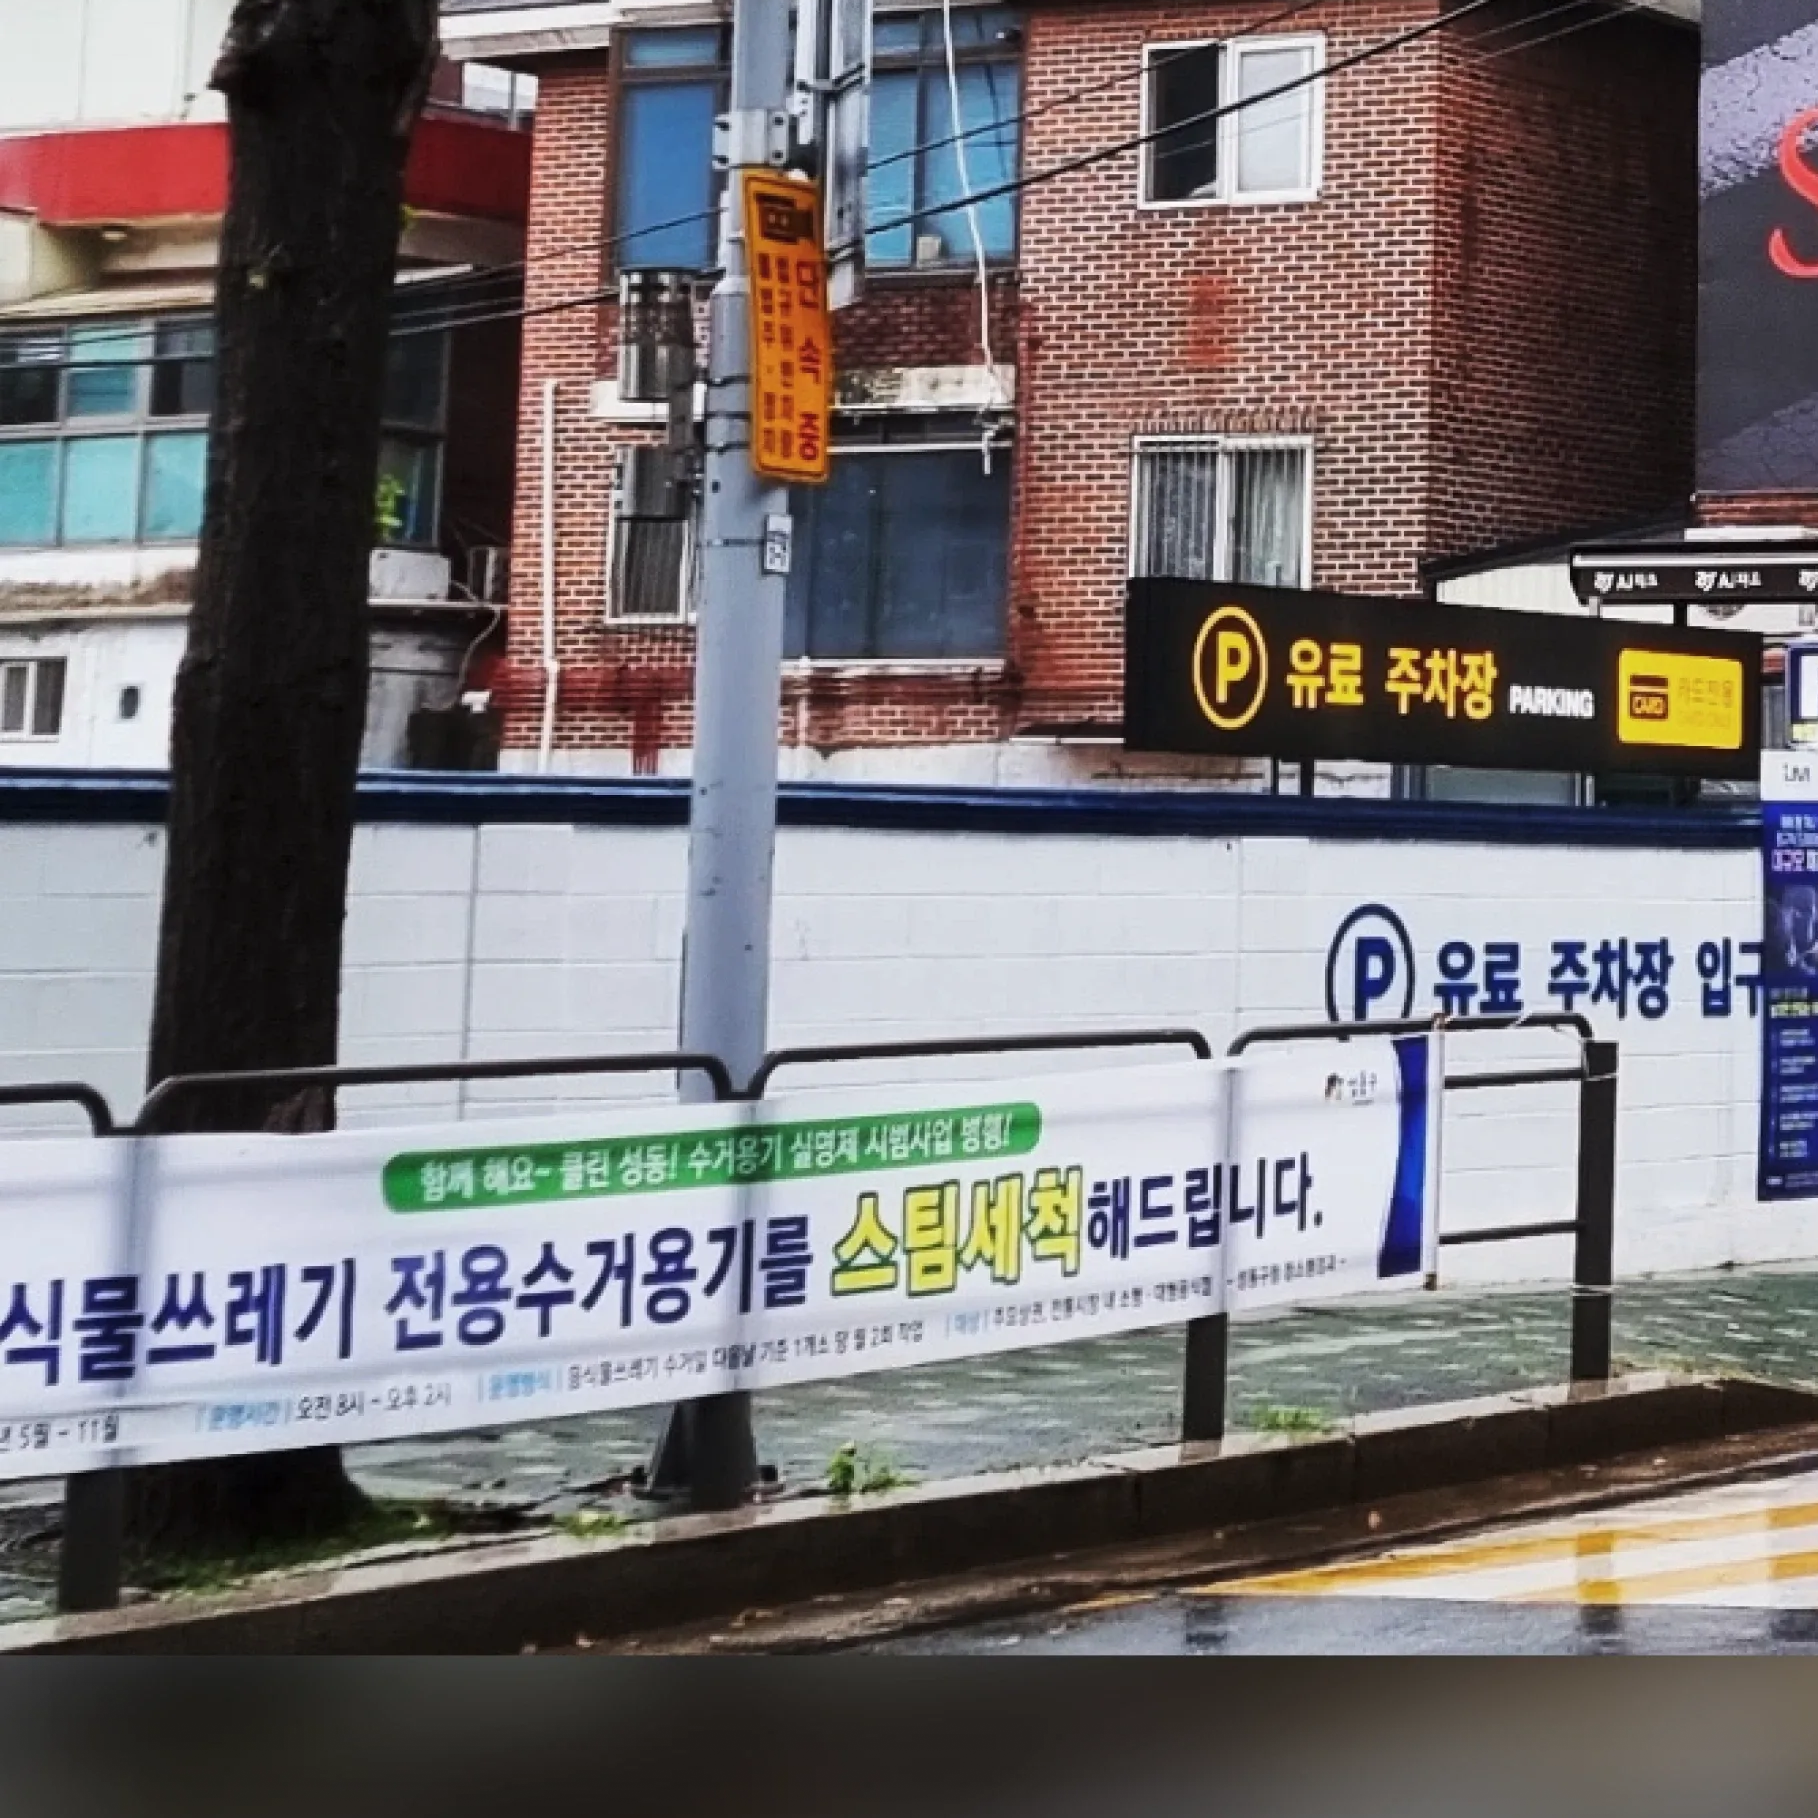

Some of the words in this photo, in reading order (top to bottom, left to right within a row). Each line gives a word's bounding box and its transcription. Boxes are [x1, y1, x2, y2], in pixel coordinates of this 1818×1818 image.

[1215, 630, 1251, 704] P
[1286, 638, 1365, 708] 유료
[1383, 647, 1499, 722] 주차장
[1508, 683, 1595, 720] PARKING
[1433, 939, 1525, 1015] 유료
[1547, 936, 1675, 1020] 주차장
[1696, 936, 1763, 1017] 입구
[420, 1160, 474, 1202] 함께
[559, 1147, 611, 1191] 클린
[618, 1141, 681, 1189] 성동!
[688, 1133, 784, 1180] 수거용기
[788, 1125, 859, 1170] 실명제
[864, 1116, 953, 1161] 시범사업
[0, 1256, 358, 1386] 식물쓰레기
[383, 1212, 814, 1352] 전용수거용기를
